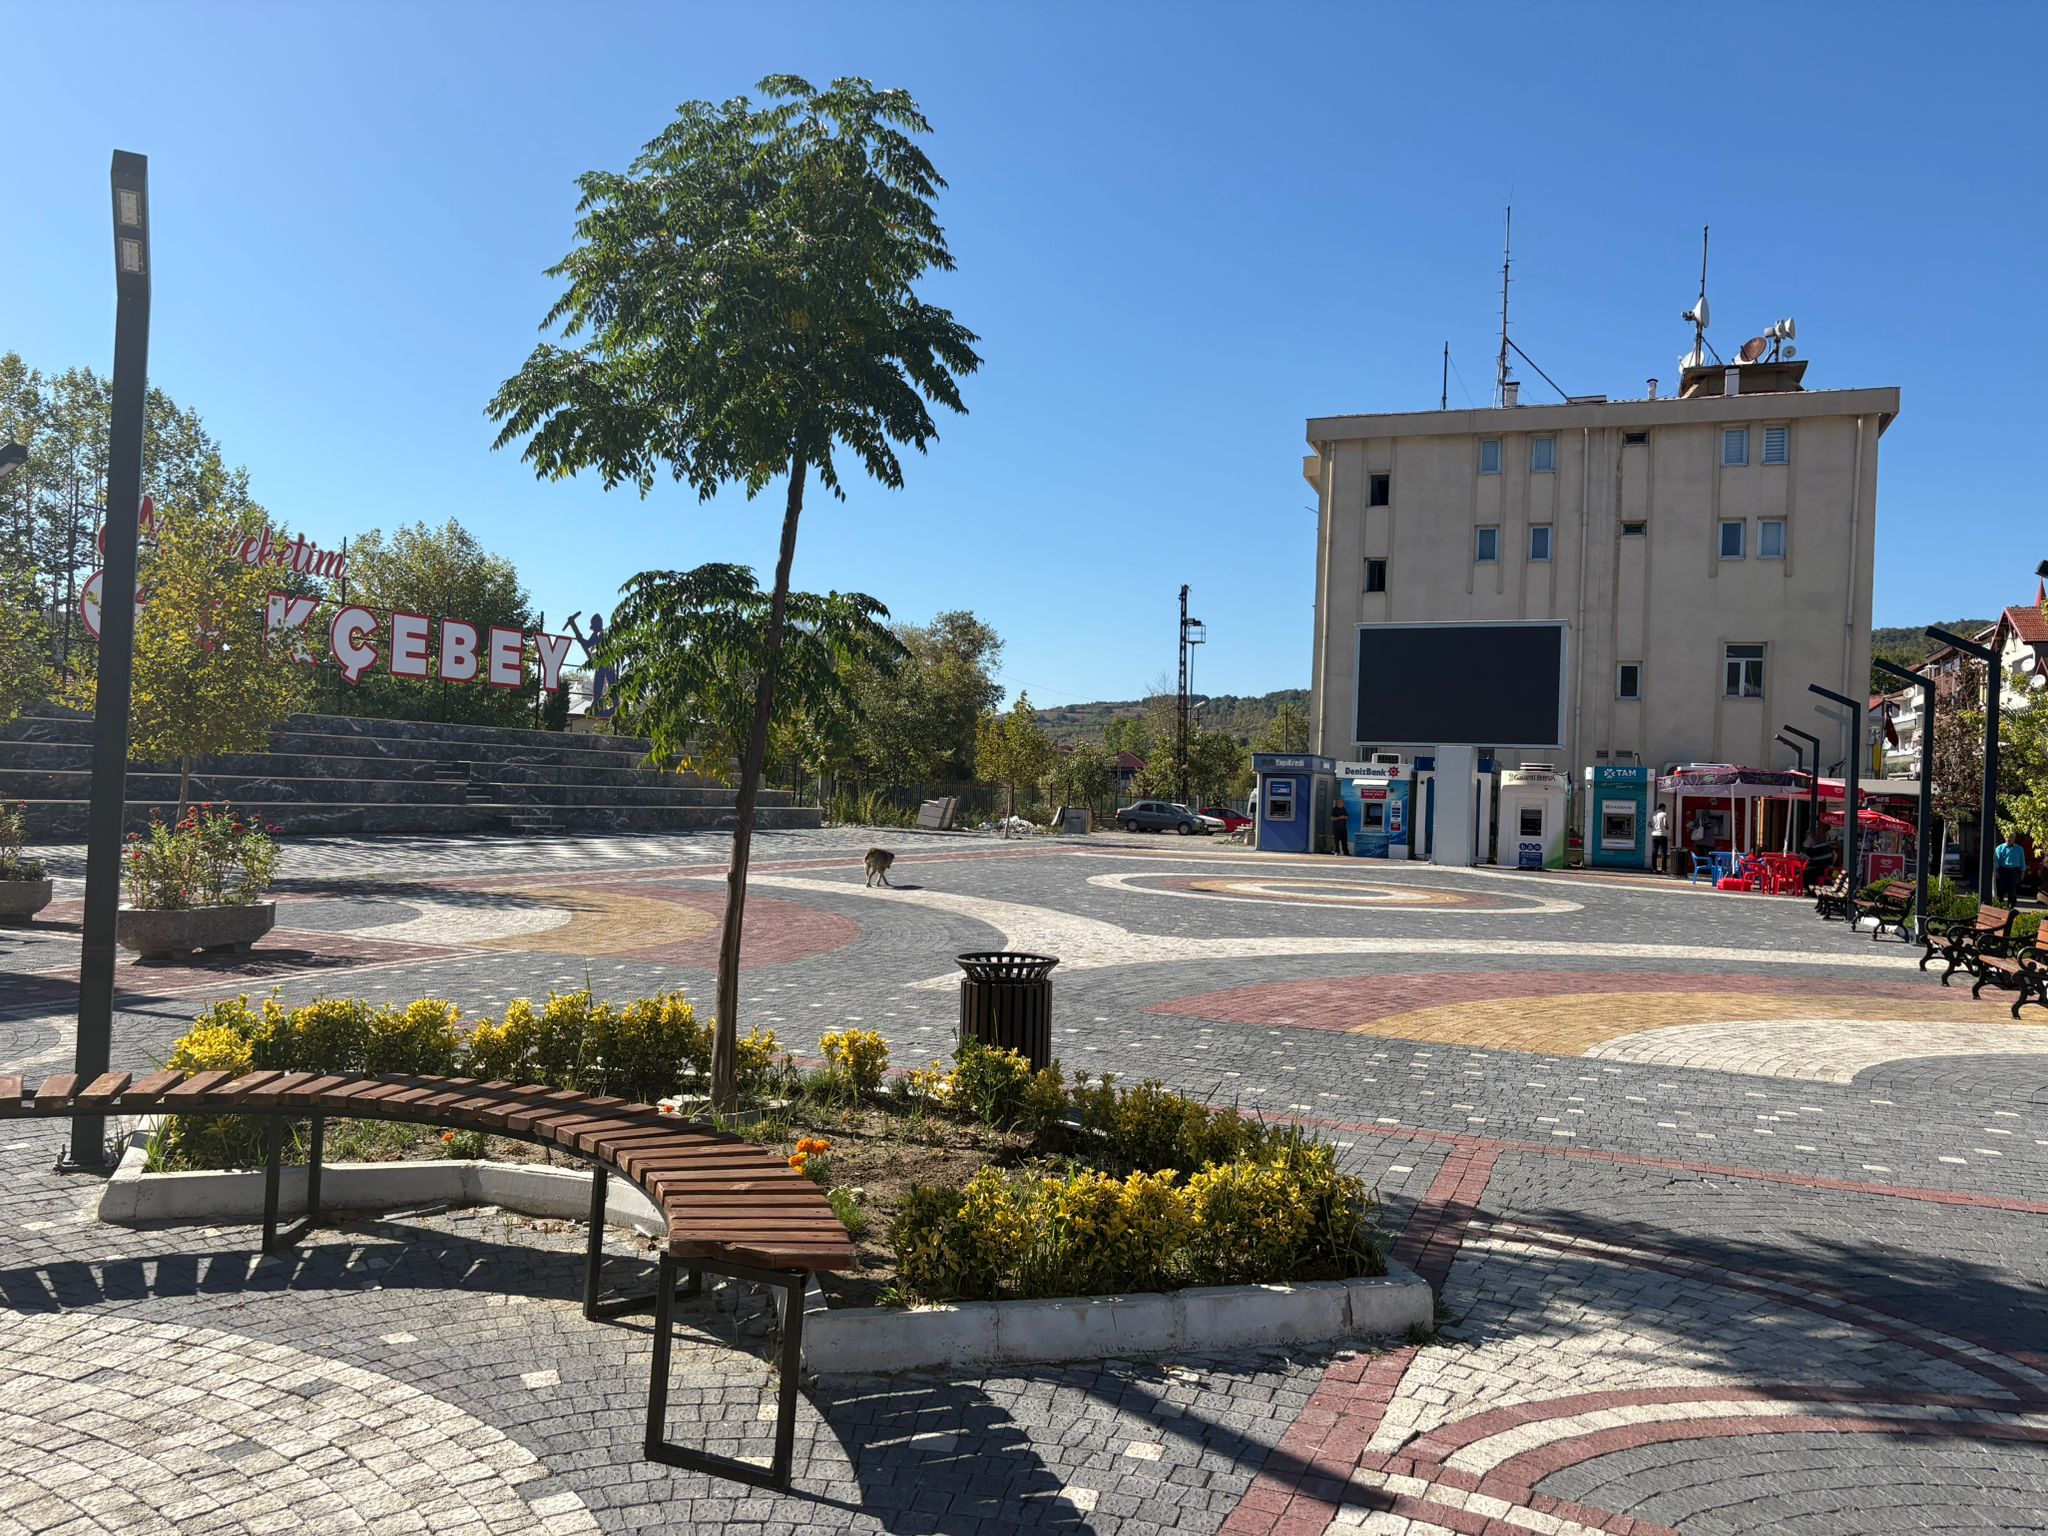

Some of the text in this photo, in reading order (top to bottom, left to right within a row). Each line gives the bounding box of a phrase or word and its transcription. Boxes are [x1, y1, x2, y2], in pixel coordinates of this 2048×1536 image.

[1345, 767, 1387, 777] DenizBank
[1615, 769, 1637, 777] TAM
[1513, 773, 1536, 781] Garanti
